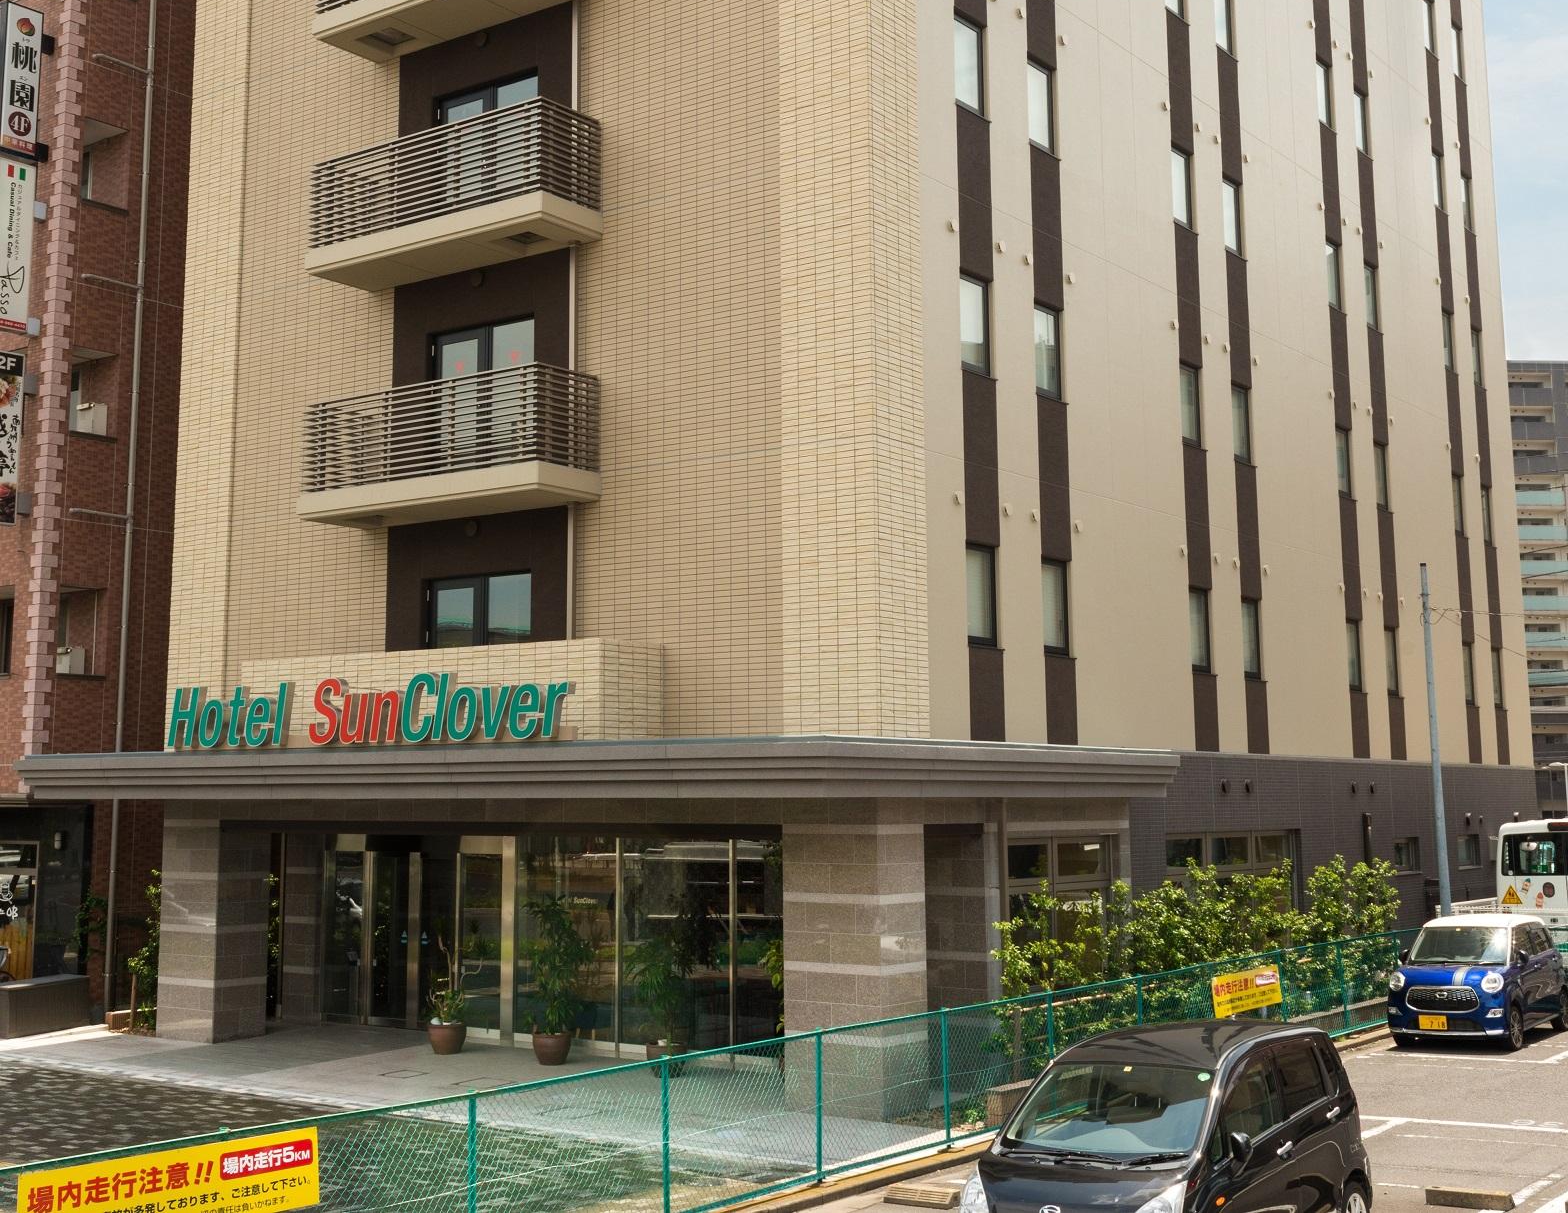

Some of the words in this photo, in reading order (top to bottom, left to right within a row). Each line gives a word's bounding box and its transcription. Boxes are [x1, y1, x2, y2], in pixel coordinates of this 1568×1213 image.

[9, 42, 37, 112] 桃園
[10, 115, 29, 132] 4F
[168, 682, 290, 748] Hotel
[308, 672, 572, 745] SunClover
[222, 1146, 310, 1175] 場内走行5KM
